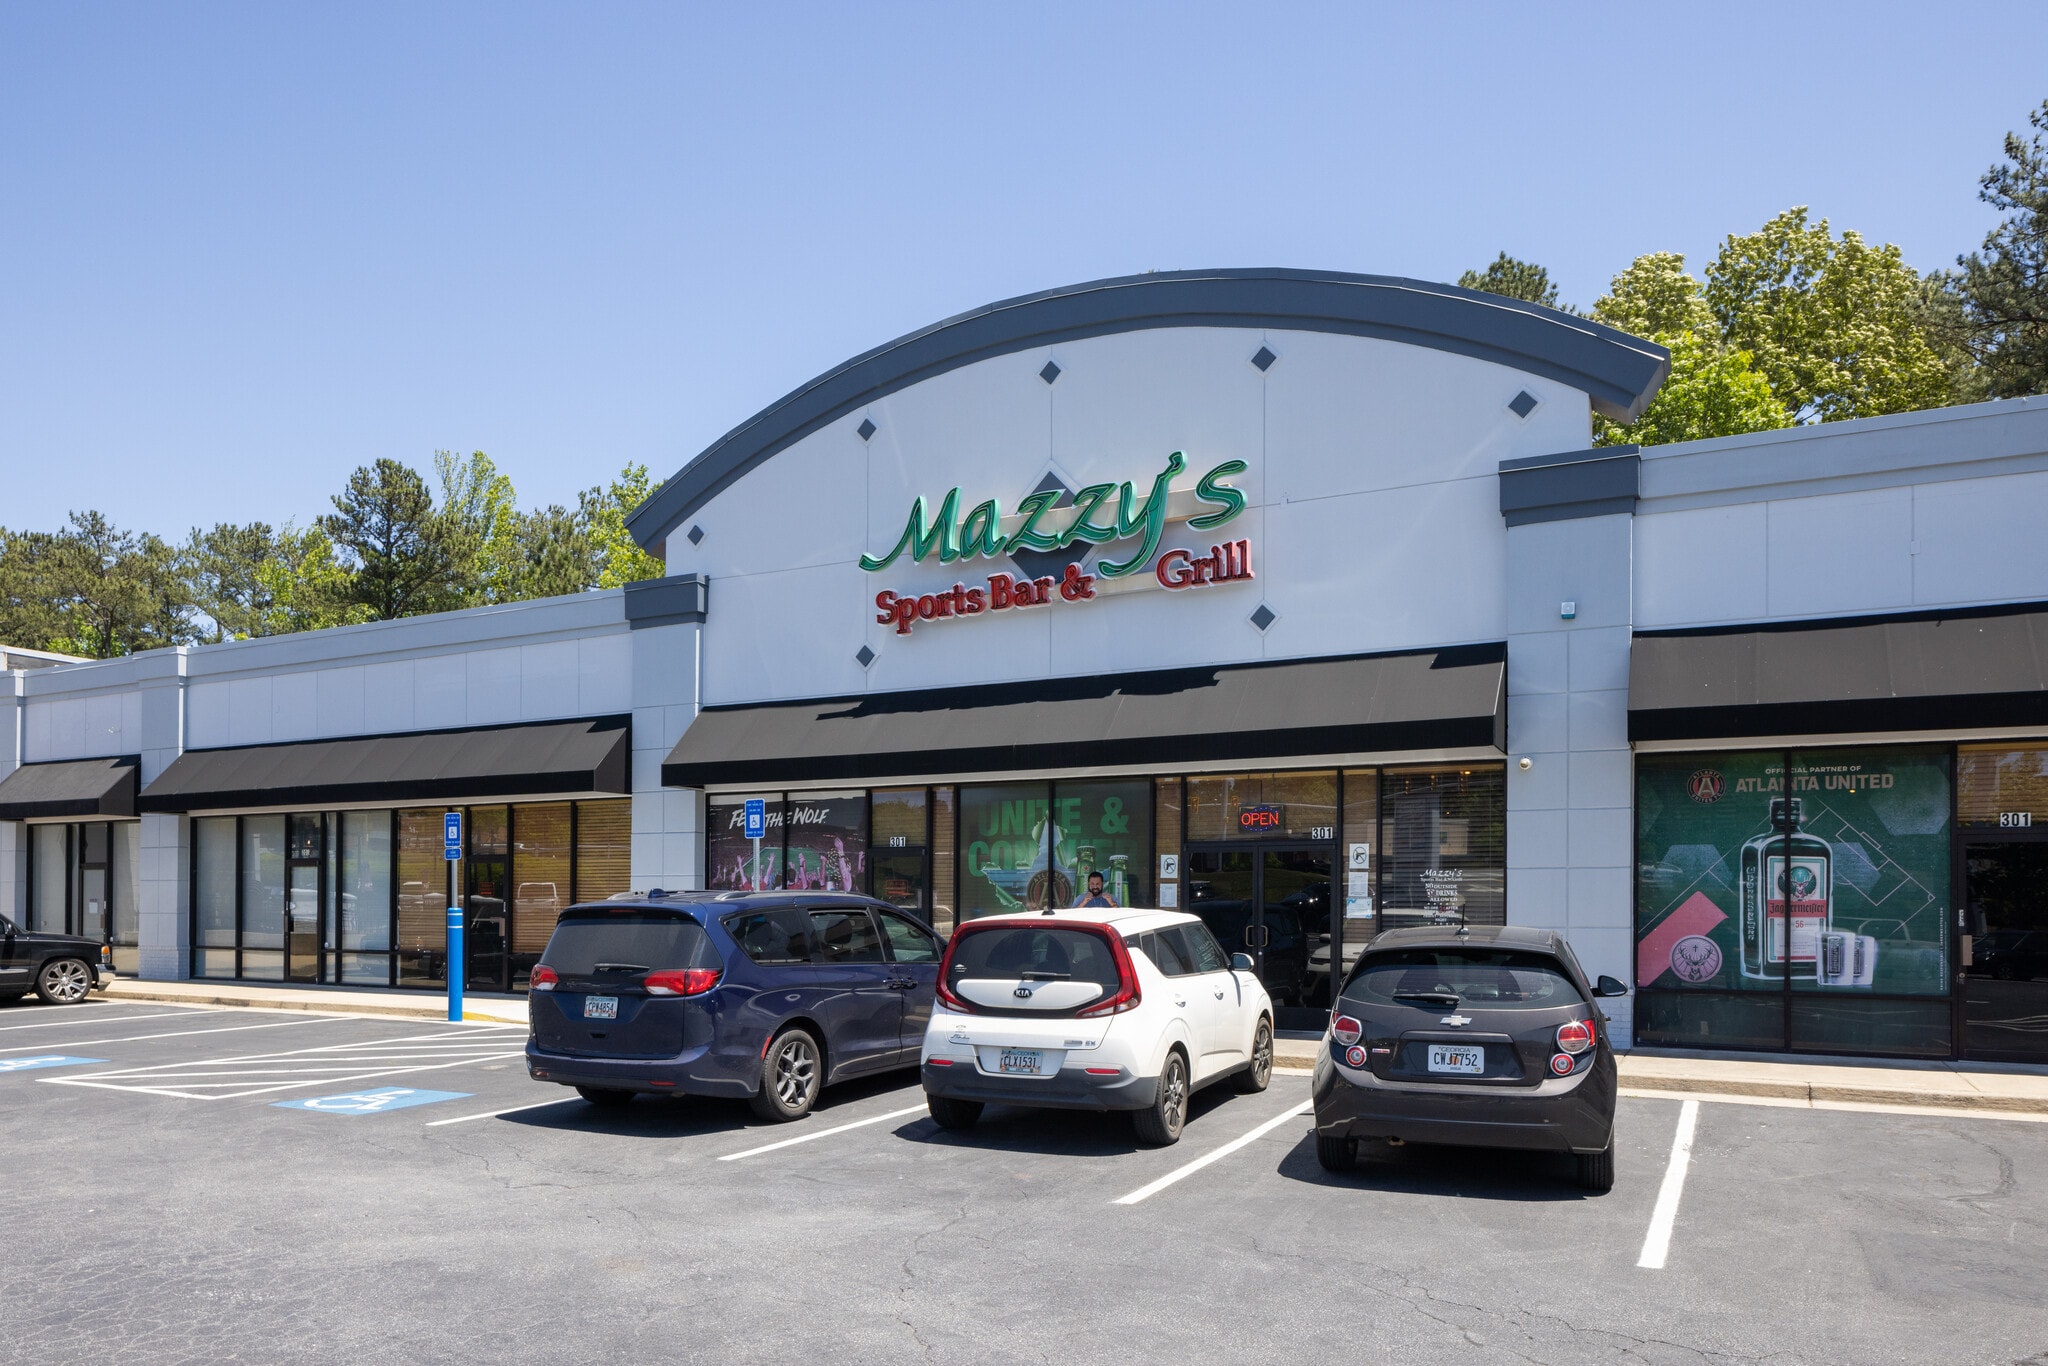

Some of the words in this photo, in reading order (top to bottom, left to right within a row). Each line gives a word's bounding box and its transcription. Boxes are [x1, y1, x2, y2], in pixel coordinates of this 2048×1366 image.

[858, 450, 1249, 580] Mazzy's
[876, 581, 987, 636] Sports
[987, 571, 1056, 612] Bar
[1060, 561, 1098, 603] &
[1155, 537, 1256, 592] Grill
[1765, 767, 1807, 775] OFFICIAL
[1809, 765, 1848, 773] PARTNER
[1850, 764, 1862, 772] OF
[1735, 776, 1820, 792] ATLANTA
[1824, 773, 1894, 790] UNITED
[1100, 796, 1129, 834] &
[1240, 811, 1279, 827] OPEN
[2001, 813, 2031, 827] 301
[1312, 827, 1333, 839] 301
[889, 837, 906, 847] 301
[1435, 889, 1458, 897] DRINKS
[1795, 919, 1804, 928] 56
[1015, 989, 1030, 997] KIA
[1003, 1055, 1037, 1068] CLX1531
